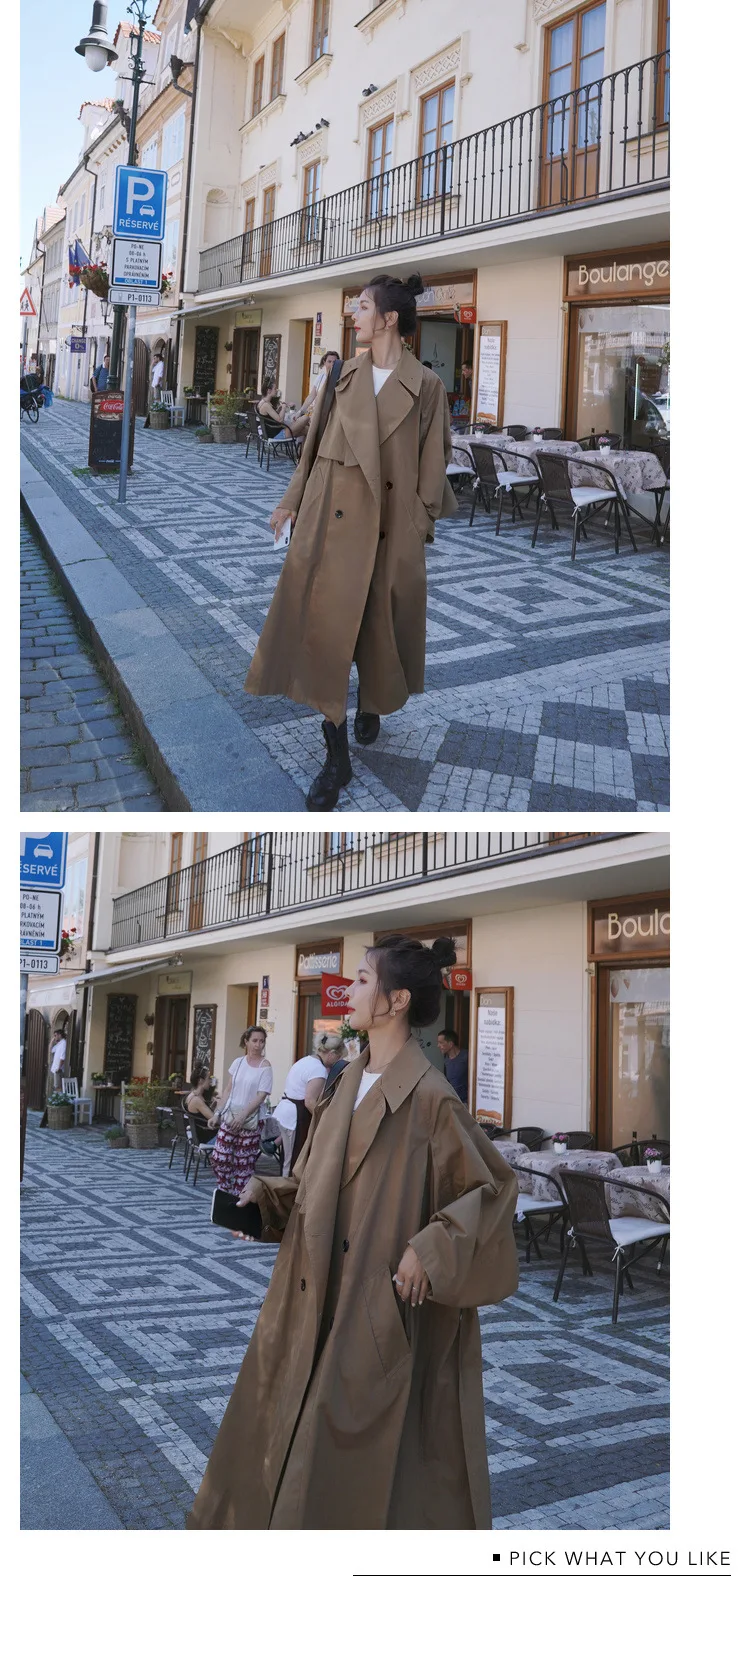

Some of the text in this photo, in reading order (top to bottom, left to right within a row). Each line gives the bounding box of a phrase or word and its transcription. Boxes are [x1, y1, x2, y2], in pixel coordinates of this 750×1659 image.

[126, 175, 155, 215] P
[119, 218, 159, 231] RÉSERVÉ
[578, 260, 670, 286] Boulange
[127, 293, 152, 303] P1-0113
[22, 893, 40, 901] PO-NE
[21, 911, 45, 919] PLATNÝM
